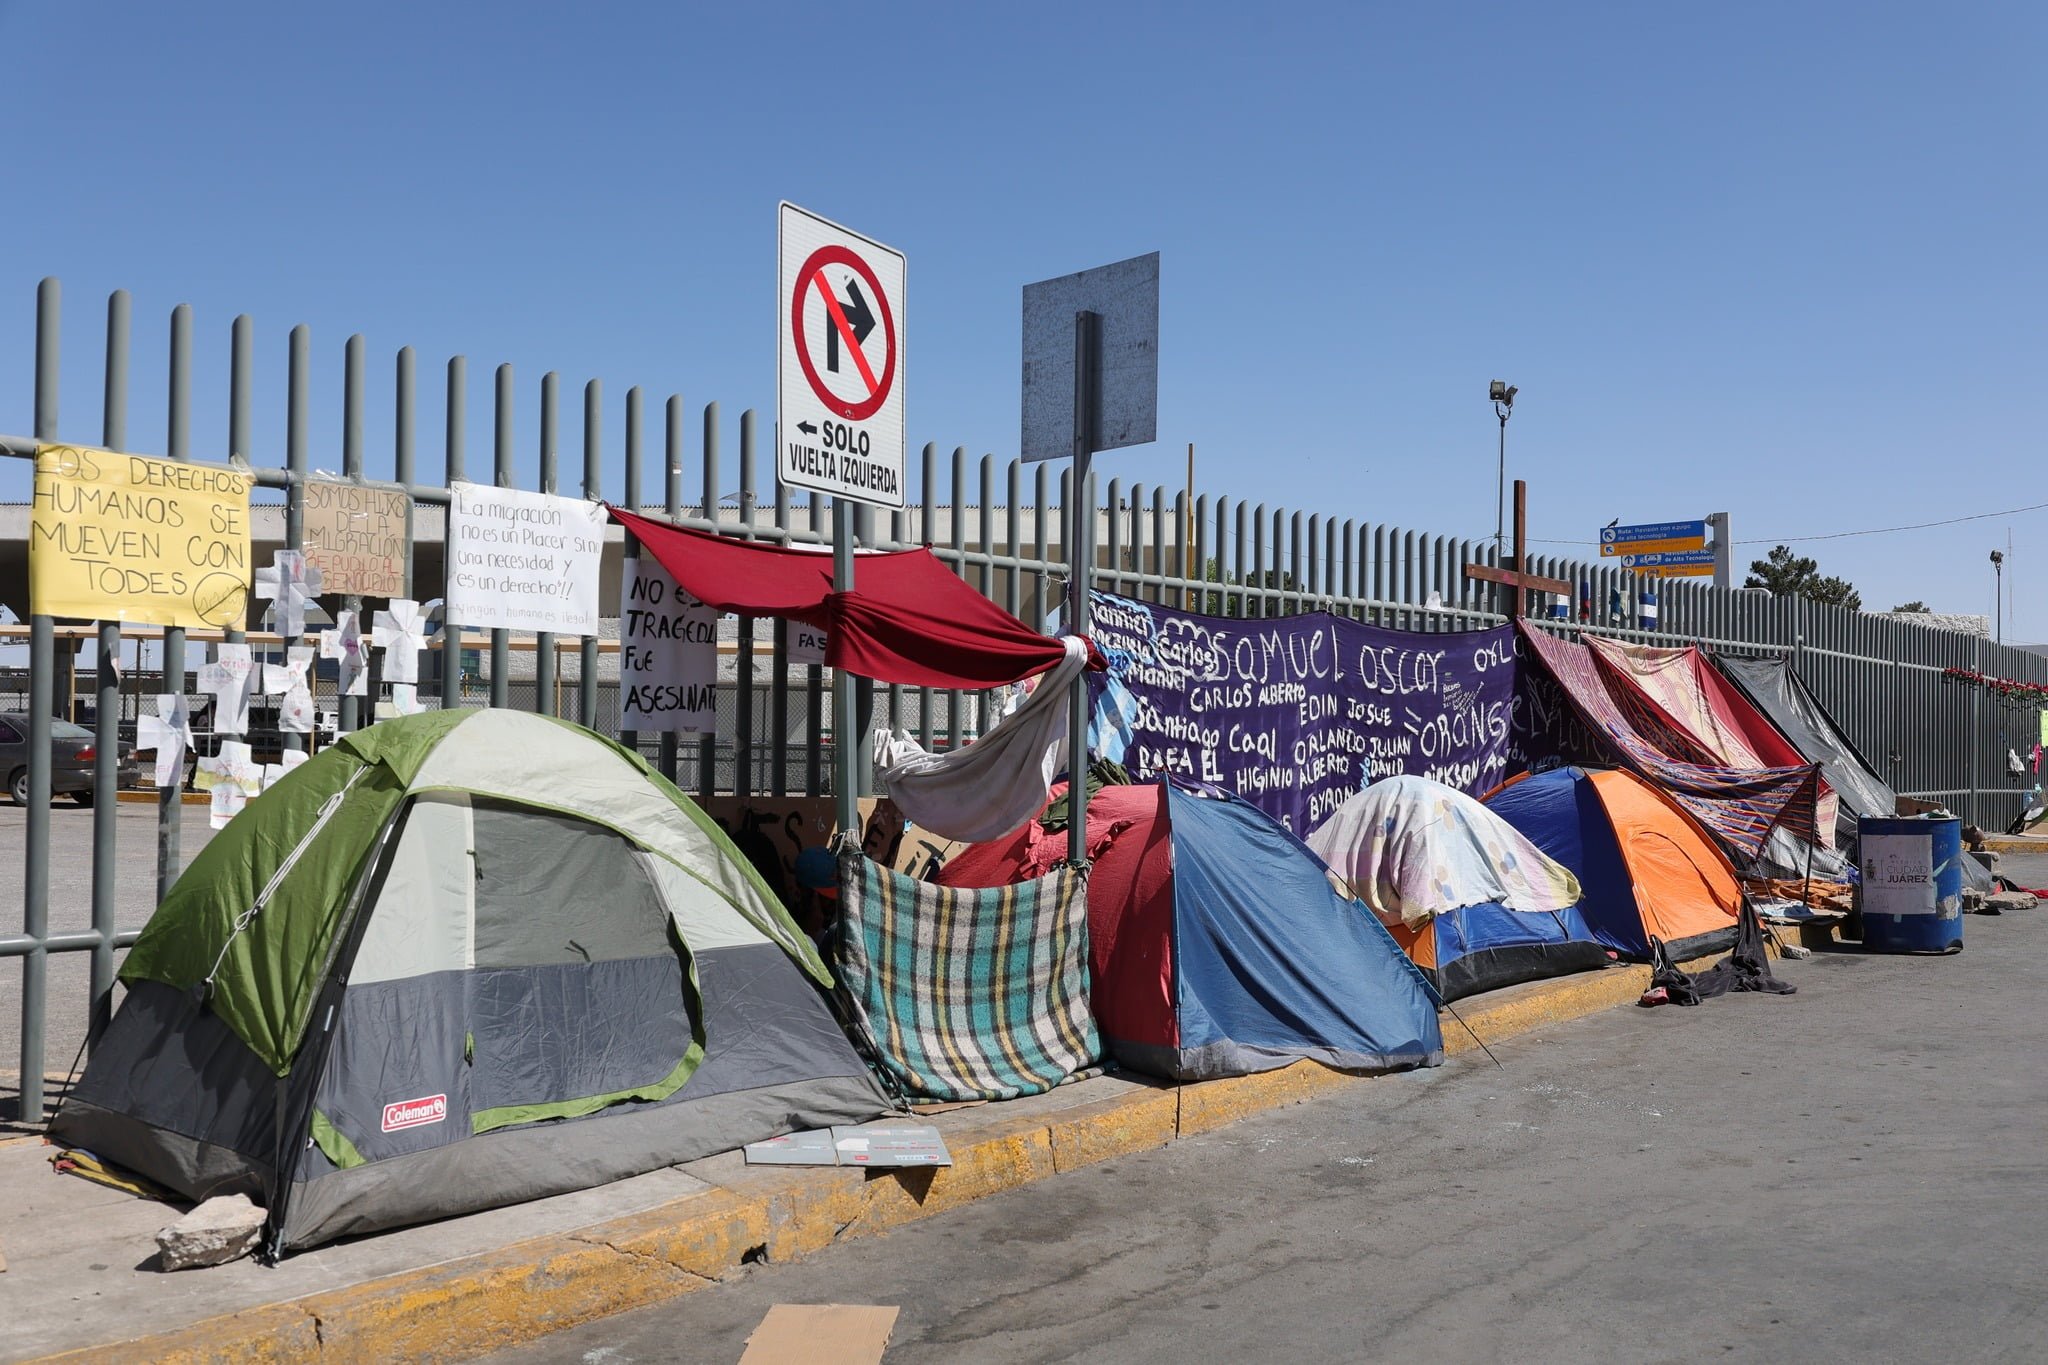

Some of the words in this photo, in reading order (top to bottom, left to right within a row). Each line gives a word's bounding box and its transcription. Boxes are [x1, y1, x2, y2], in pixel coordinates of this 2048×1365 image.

[823, 420, 870, 457] SOLO
[130, 456, 244, 495] DERECHOS
[789, 443, 836, 480] VUELTA
[841, 455, 897, 495] IZQUIERDA
[33, 481, 183, 527] HUMANOS
[210, 504, 241, 535] SE
[306, 483, 360, 510] SOMOS
[336, 511, 360, 533] DE
[367, 515, 390, 535] LA
[489, 503, 561, 529] migración
[32, 520, 160, 558] MUEVEN
[187, 535, 243, 569] CON
[310, 526, 405, 559] MIGRACIÓN
[461, 524, 480, 540] no
[483, 528, 497, 542] es
[502, 530, 518, 544] un
[70, 558, 187, 595] TODES
[457, 550, 482, 566] una
[488, 553, 553, 571] necesidad
[564, 559, 573, 577] y
[457, 573, 475, 587] es
[479, 577, 496, 591] un
[630, 575, 664, 604] NO
[1190, 683, 1252, 712] CARLOS
[1257, 682, 1306, 707] ALBERTO
[1300, 694, 1338, 726] EDIN
[1347, 697, 1392, 727] JOSUE
[1131, 695, 1220, 748] Santiago
[1229, 723, 1276, 763] Caal
[1369, 735, 1411, 760] JULIAN
[1299, 752, 1350, 790] ALBERTO
[1370, 757, 1404, 778] DAVID
[1886, 865, 1929, 874] CIUDAD
[1887, 873, 1929, 884] JUÁREZ
[386, 1103, 434, 1125] Coleman
